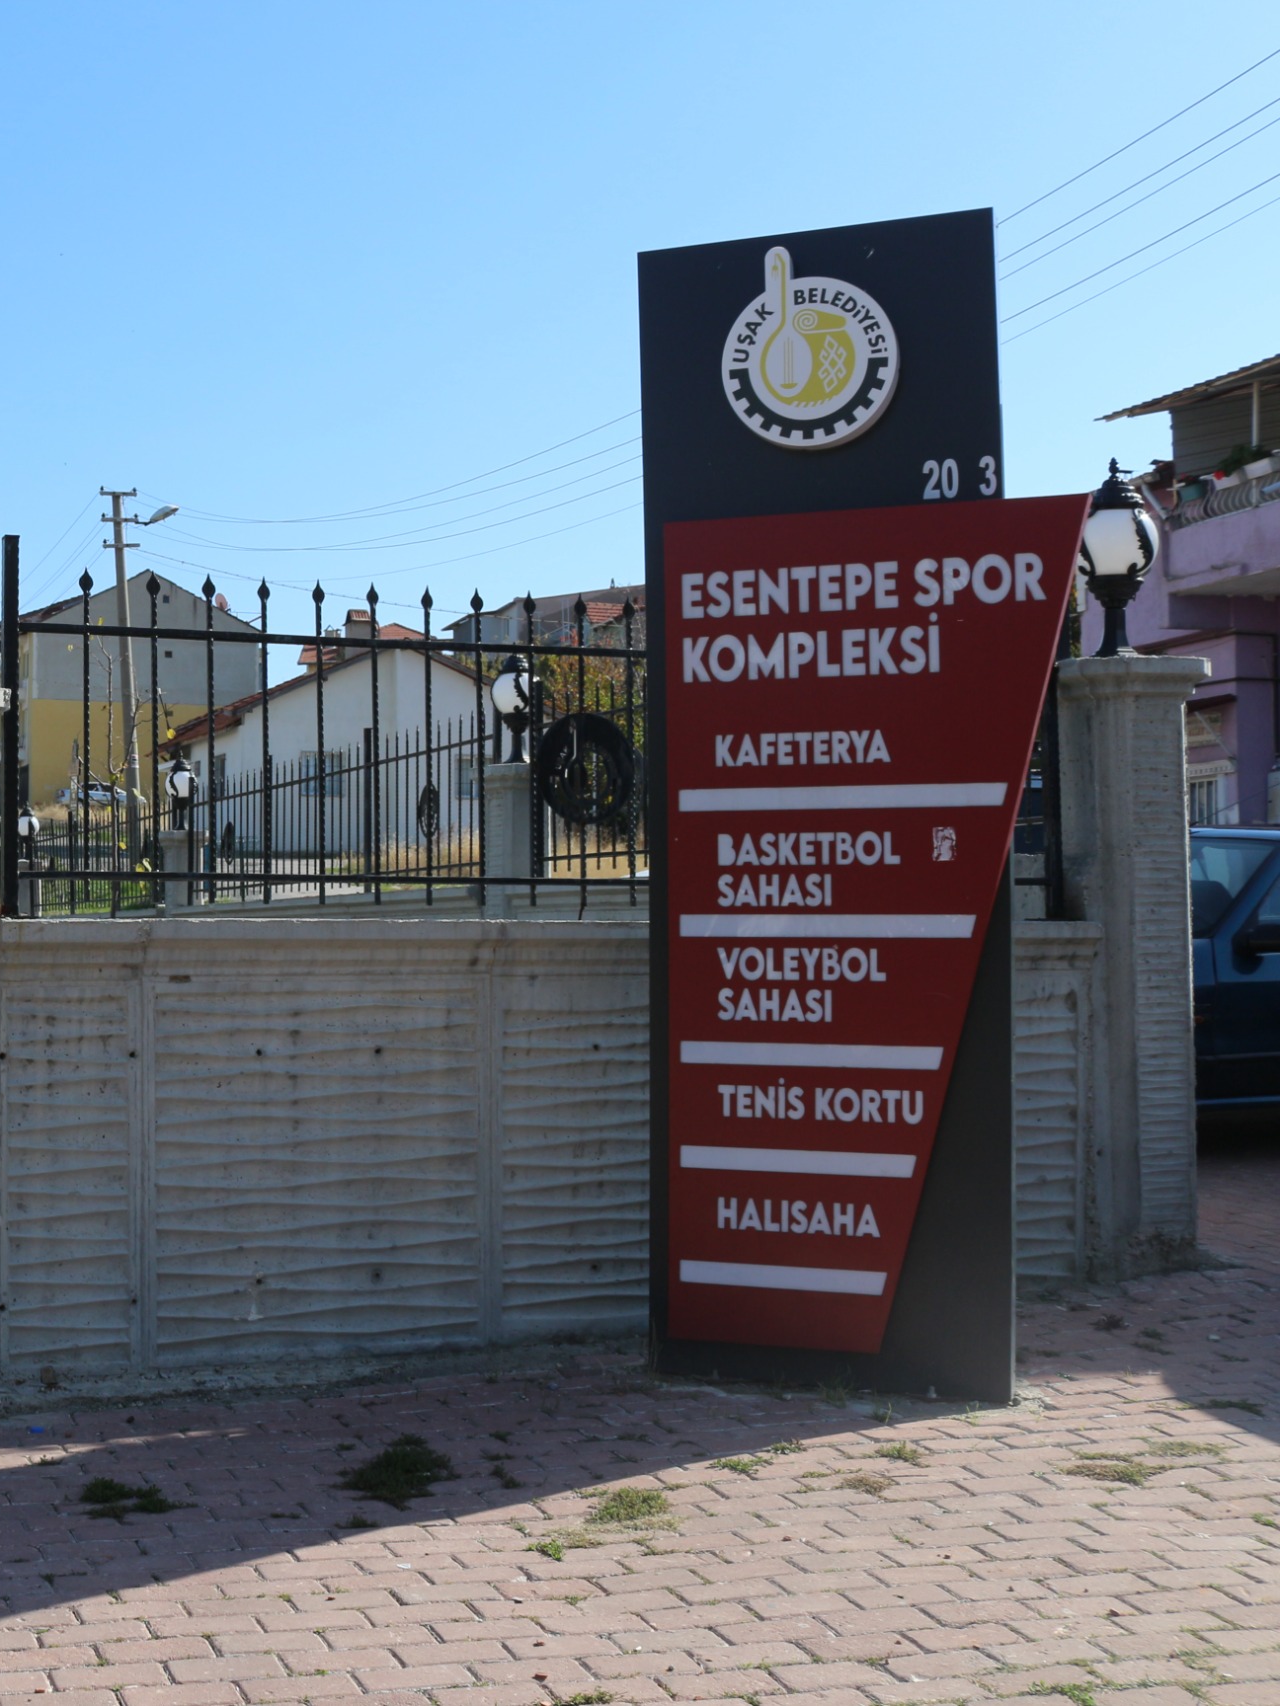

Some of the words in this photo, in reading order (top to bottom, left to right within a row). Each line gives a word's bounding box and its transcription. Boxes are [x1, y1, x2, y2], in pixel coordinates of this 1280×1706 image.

[732, 302, 775, 364] UŞAK
[681, 560, 900, 619] ESENTEPE
[914, 552, 1047, 607] SPOR
[682, 612, 941, 683] KOMPLEKSİ
[715, 729, 891, 767] KAFETERYA
[718, 831, 901, 866] BASKETBOL
[718, 873, 832, 908] SAHASI
[717, 947, 886, 982] VOLEYBOL
[717, 988, 832, 1022] SAHASI
[718, 1077, 804, 1120] TENİS
[815, 1087, 924, 1125] KORTU
[717, 1197, 880, 1238] HALISAHA
